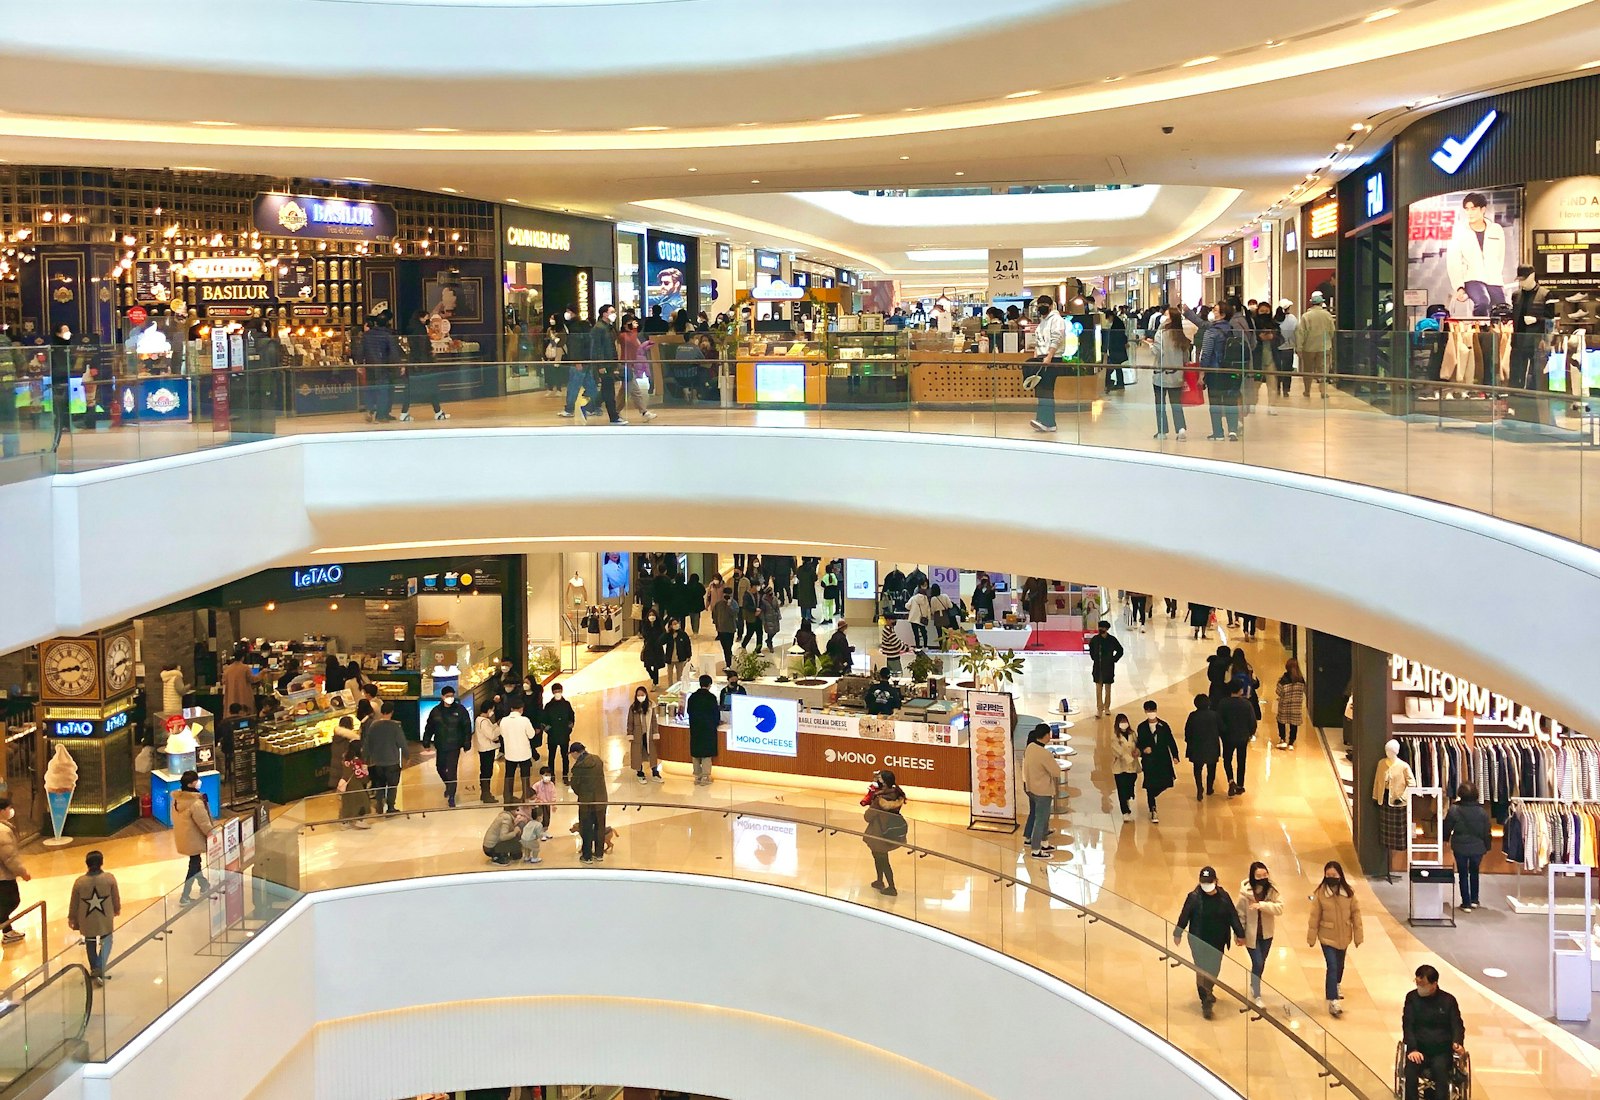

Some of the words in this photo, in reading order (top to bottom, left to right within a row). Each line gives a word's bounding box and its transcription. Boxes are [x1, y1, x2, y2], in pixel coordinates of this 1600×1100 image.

[313, 203, 374, 226] BASILUR
[1409, 209, 1455, 227] 한민국
[1409, 225, 1453, 241] 리지널
[658, 240, 686, 264] GUESS
[202, 285, 270, 300] BASILUR
[294, 565, 343, 587] LeTAO
[934, 568, 957, 583] 50
[1392, 653, 1490, 715] PLATFORM
[1491, 693, 1563, 747] PLACE
[56, 721, 93, 736] LeTAO
[813, 718, 829, 726] CREAM
[830, 719, 847, 728] CHEESE
[736, 735, 761, 744] MONO
[762, 737, 793, 748] CHEESE
[837, 750, 876, 765] MONO
[883, 755, 935, 771] CHEESE
